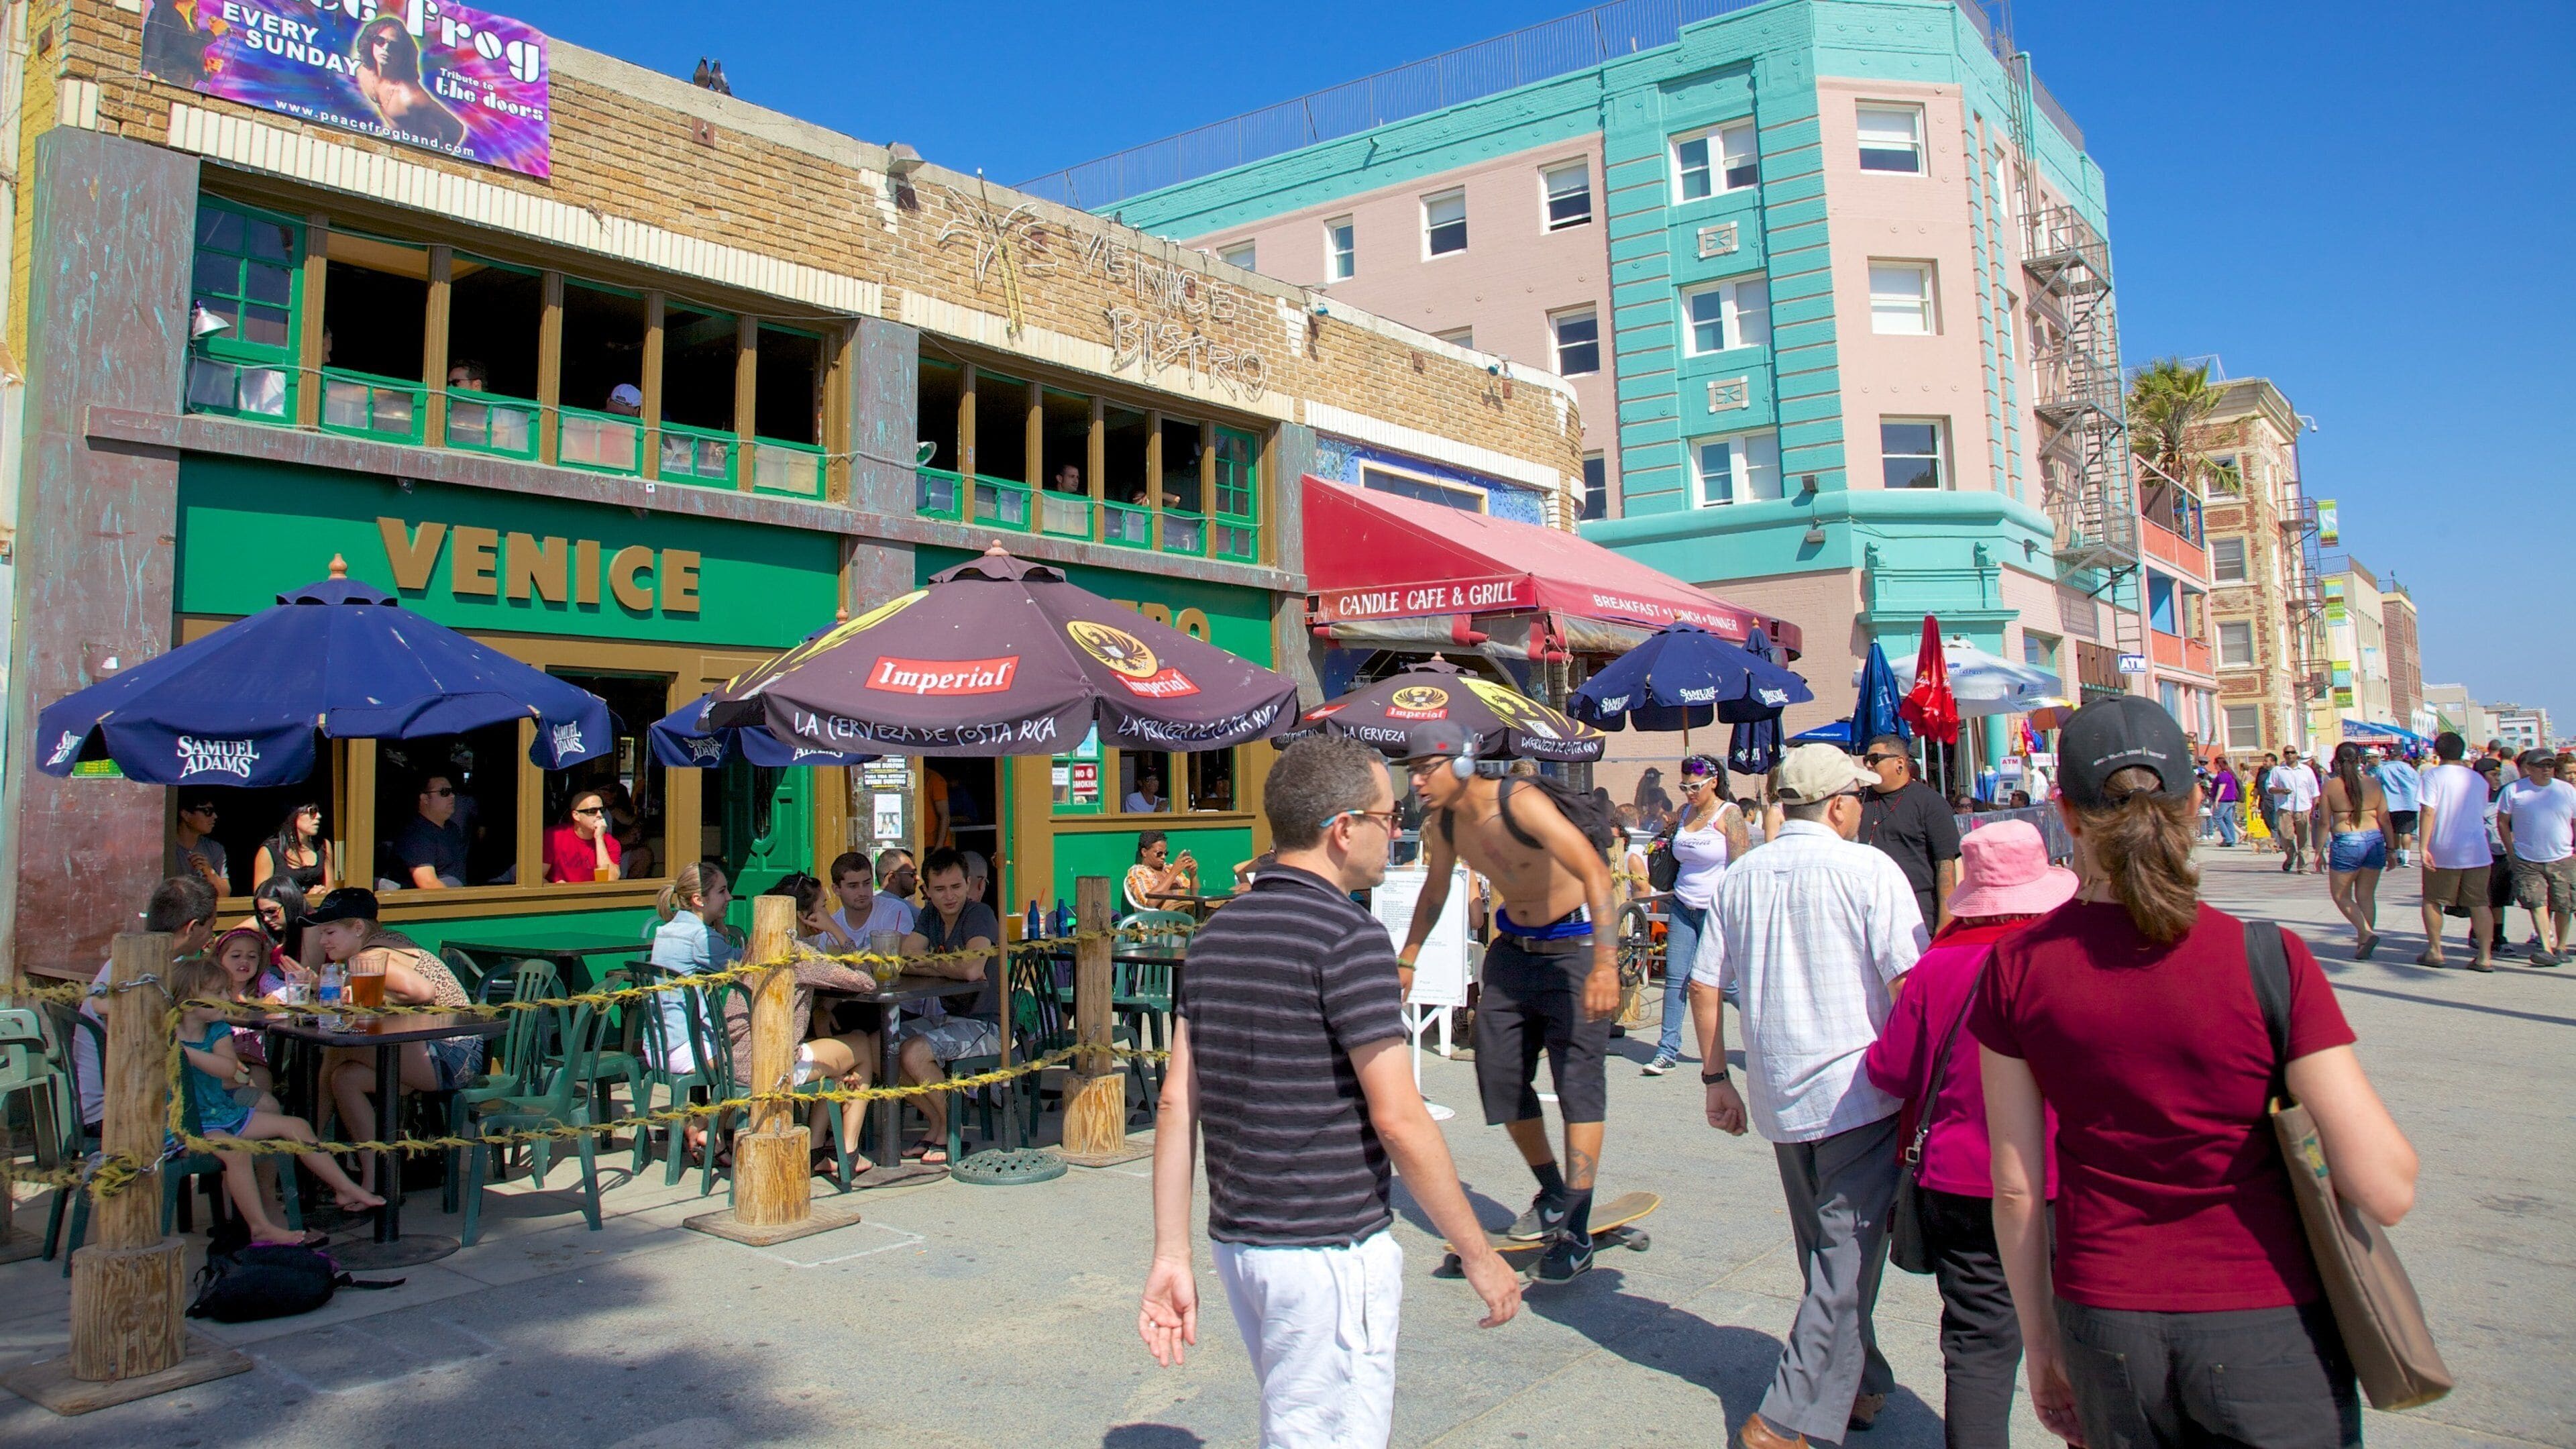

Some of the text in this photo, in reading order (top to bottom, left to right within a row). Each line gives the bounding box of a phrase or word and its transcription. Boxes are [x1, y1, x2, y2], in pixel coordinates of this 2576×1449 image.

[223, 1, 319, 44] EVERY
[246, 30, 362, 76] SUNDAY
[440, 67, 494, 91] Tribute to
[436, 76, 545, 121] the doors
[275, 100, 474, 157] www.peacefrogband.com
[1067, 216, 1236, 318] VENICE
[1109, 307, 1269, 394] BISTRO
[376, 516, 701, 612] VENICE
[1340, 581, 1517, 615] CANDLE CAFE & GRILL
[1593, 594, 1660, 617] BREAKFAST
[1706, 614, 1738, 631] DINNER
[2121, 657, 2146, 669] ATM
[878, 661, 1011, 695] Imperial
[1116, 672, 1191, 696] Imperial
[1679, 686, 1719, 697] SAMUEL
[1684, 694, 1715, 703] ADAMS
[1389, 708, 1444, 719] Imperial
[553, 720, 582, 743] SAMUEL
[794, 712, 1057, 747] LA CERVEZA DE COSTA RICA
[1117, 715, 1138, 737] LA
[1343, 725, 1355, 738] LA
[1359, 726, 1406, 742] CERVEZA
[177, 735, 260, 759] SAMUEL
[556, 737, 586, 762] ADAMS
[692, 746, 720, 763] ADAMS
[180, 755, 252, 778] ADAMS
[1075, 769, 1085, 777] NO
[1073, 780, 1097, 788] SMOKING
